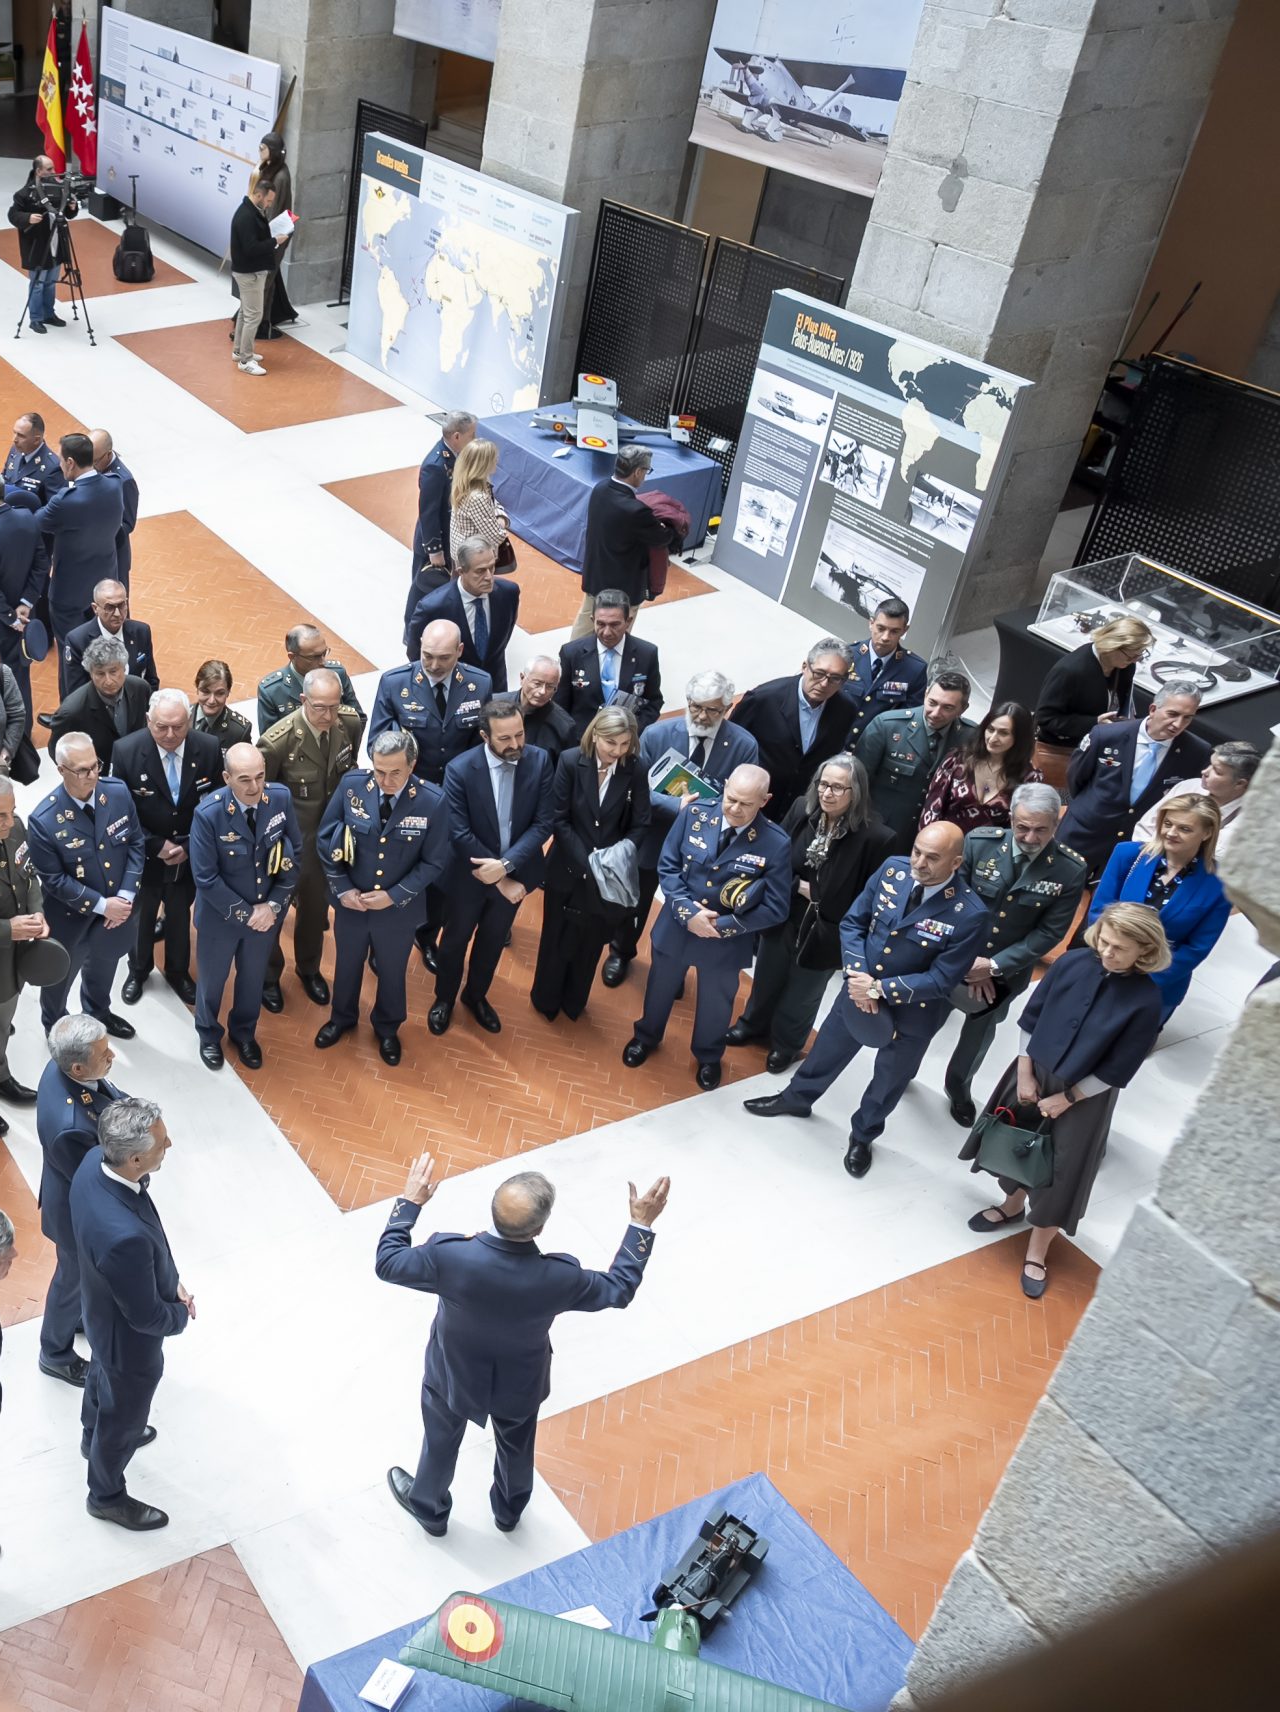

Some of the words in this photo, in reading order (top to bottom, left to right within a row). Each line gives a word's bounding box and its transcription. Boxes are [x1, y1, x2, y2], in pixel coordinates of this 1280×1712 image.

[796, 313, 805, 328] El
[804, 314, 819, 334] Plus
[819, 322, 836, 341] Ultra
[791, 328, 830, 359] Palos-Buenos
[828, 342, 846, 366] Aires
[843, 348, 851, 367] /
[848, 349, 864, 372] 1926
